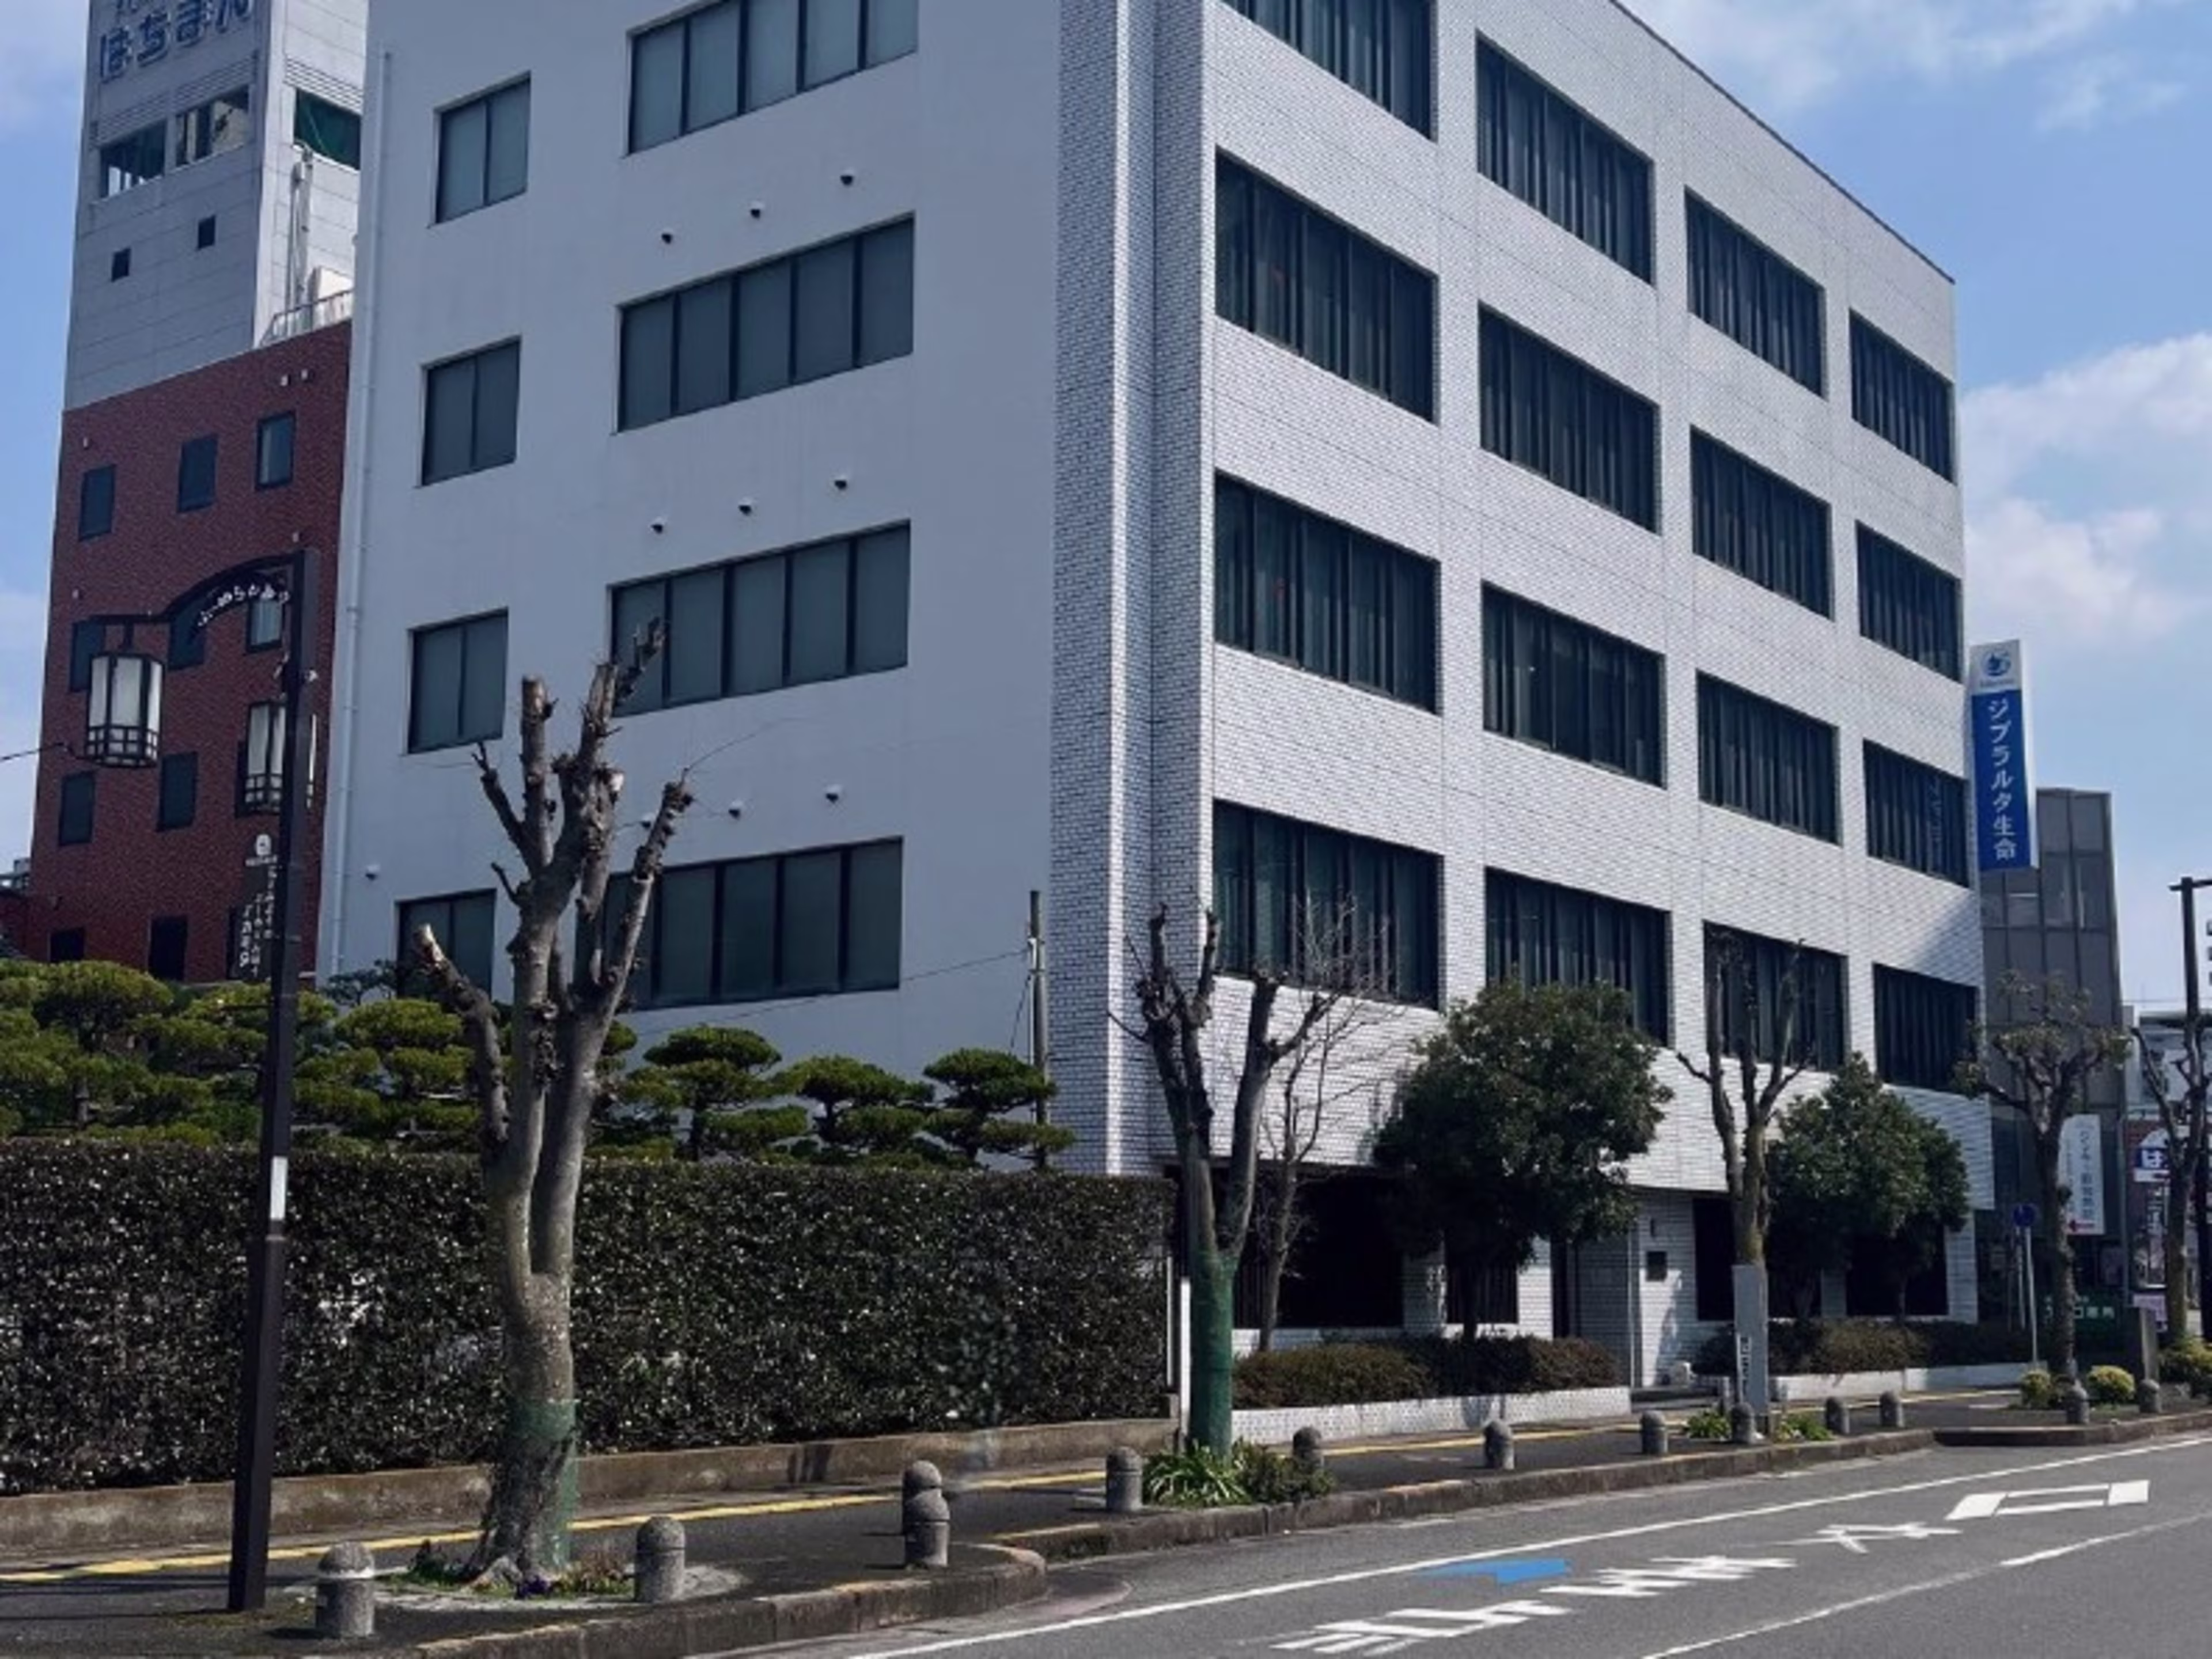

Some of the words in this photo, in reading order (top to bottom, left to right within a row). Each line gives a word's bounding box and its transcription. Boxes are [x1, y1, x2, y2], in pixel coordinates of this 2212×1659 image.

[1988, 698, 2017, 861] ジブラルタ生命
